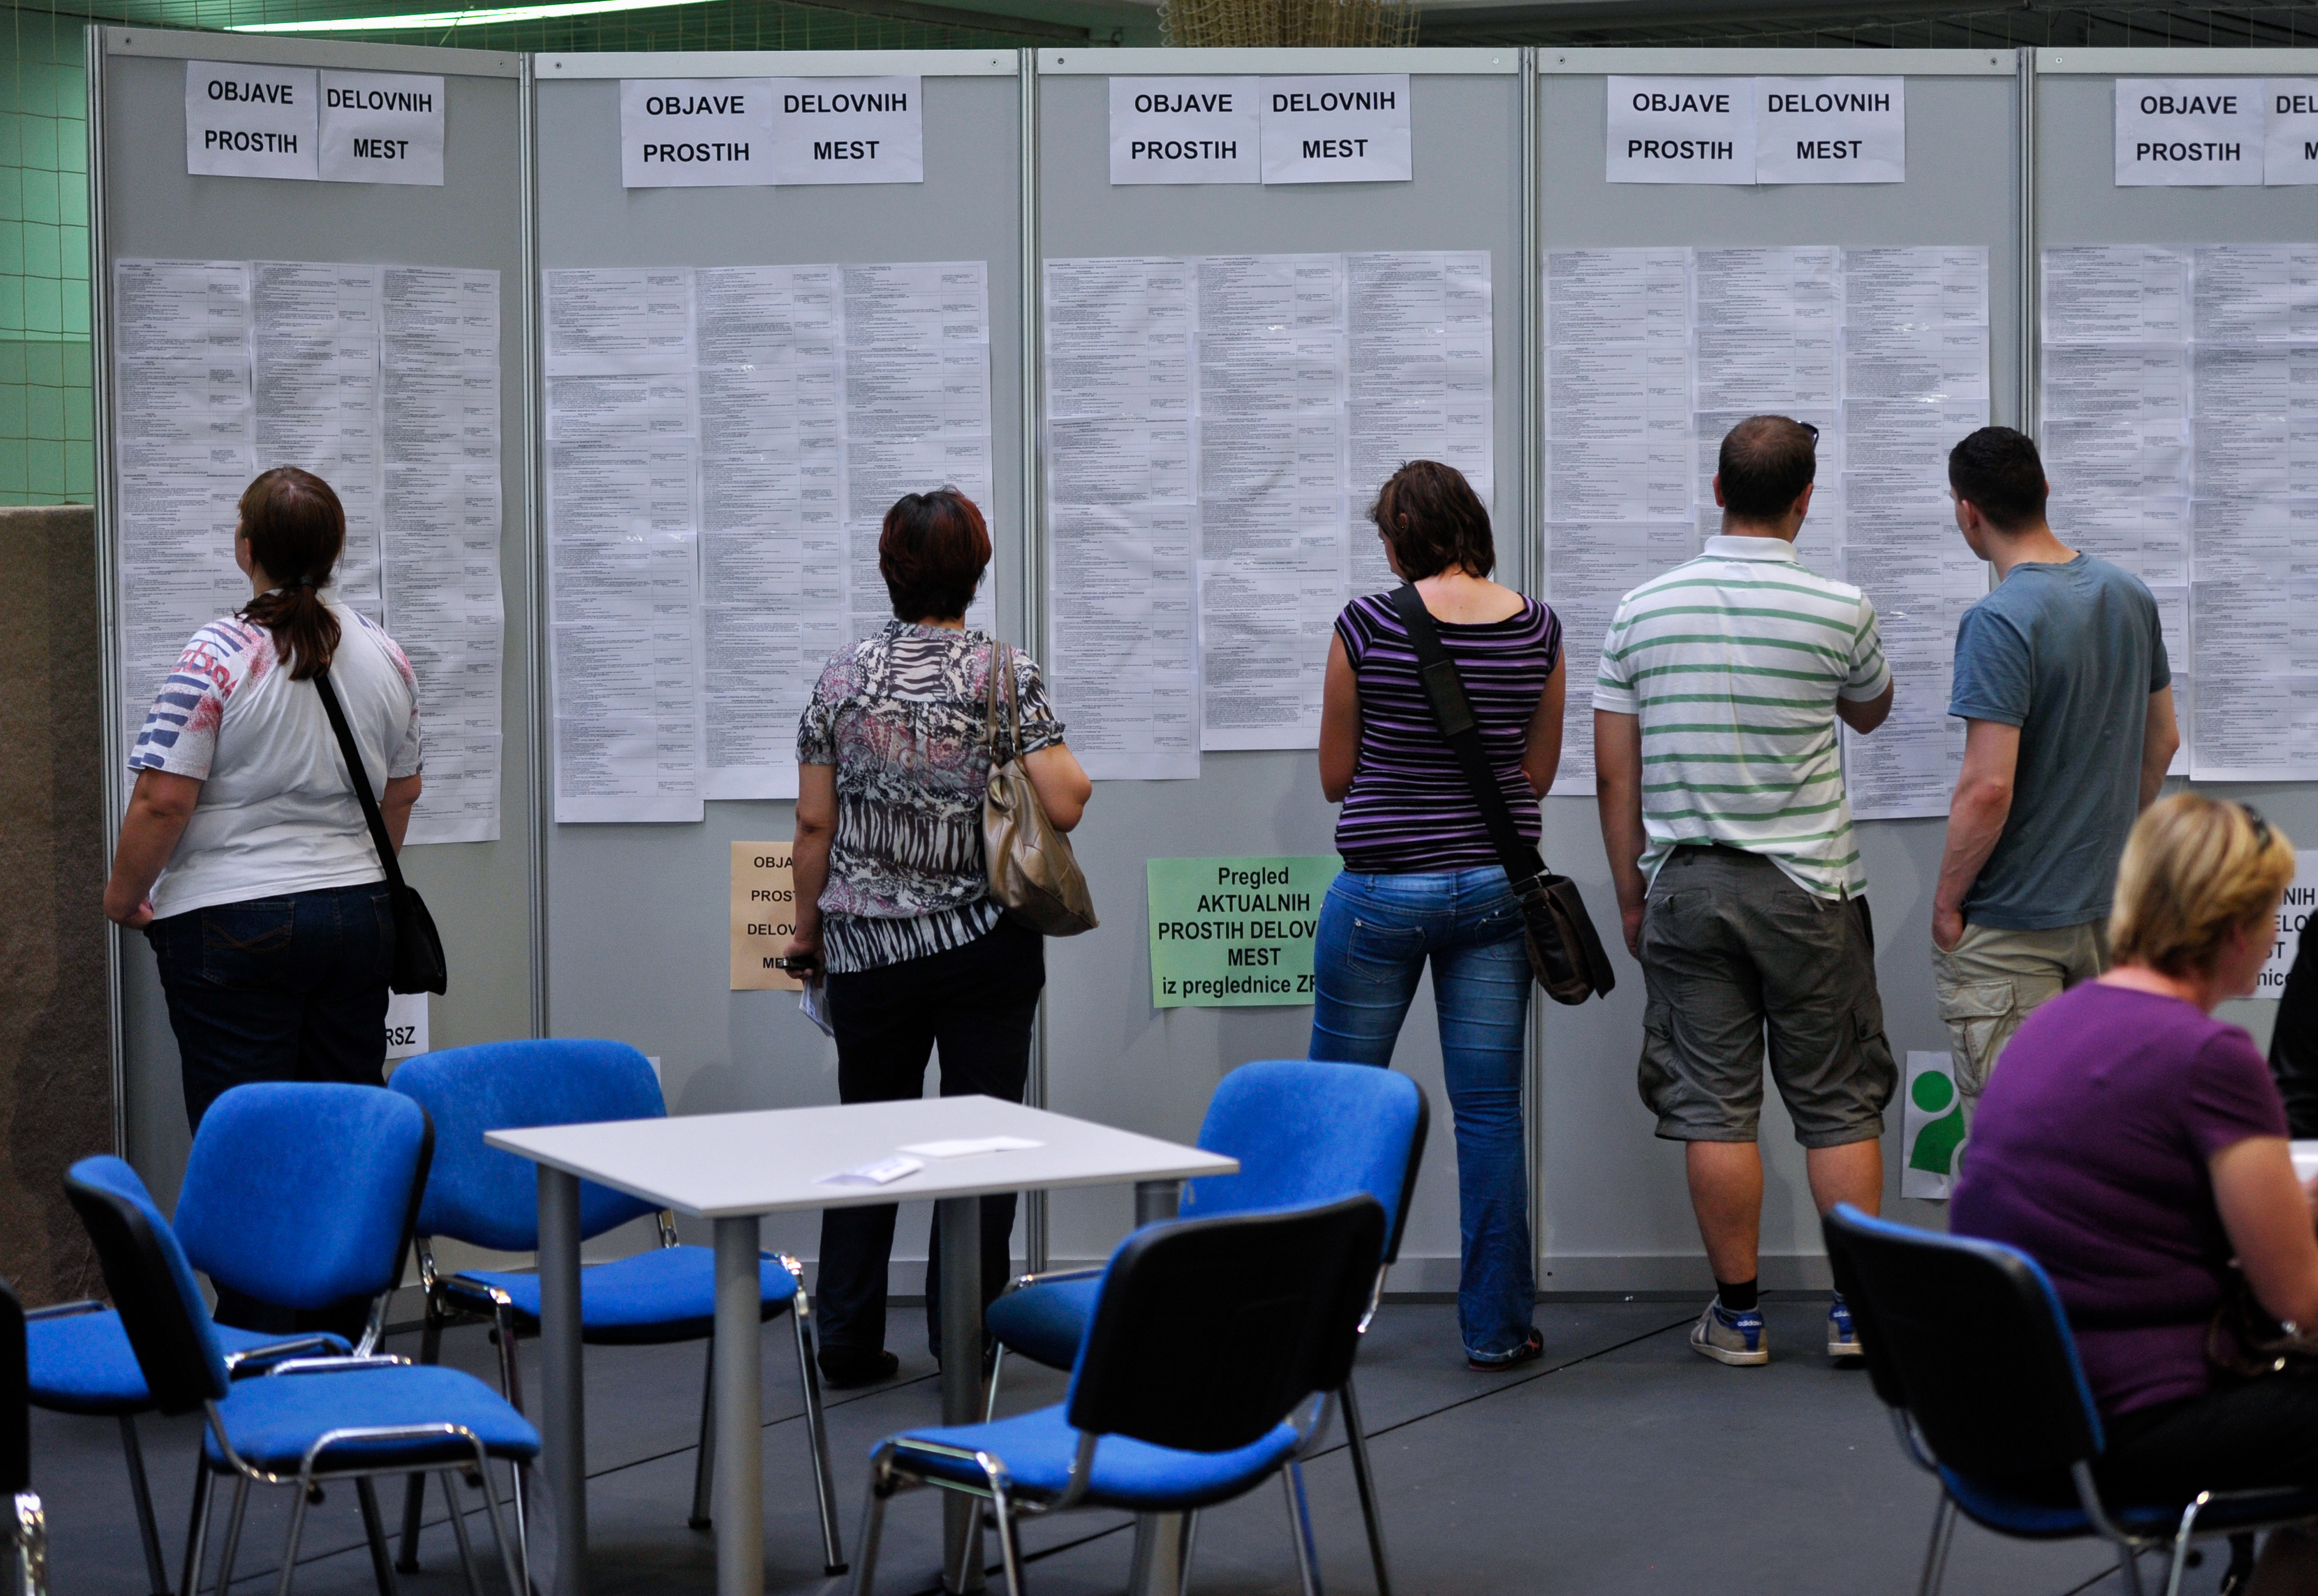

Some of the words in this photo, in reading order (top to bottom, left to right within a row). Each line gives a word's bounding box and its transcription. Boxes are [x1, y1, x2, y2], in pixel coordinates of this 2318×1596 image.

[207, 80, 293, 104] OBJAVE
[327, 89, 432, 112] DELOVNIH
[646, 96, 745, 115] OBJAVE
[784, 93, 907, 113] DELOVNIH
[1135, 94, 1233, 113] OBJAVE
[1273, 92, 1395, 112] DELOVNIH
[1632, 93, 1730, 113] OBJAVE
[1769, 93, 1889, 112] DELOVNIH
[2141, 96, 2237, 115] OBJAVE
[205, 130, 297, 154] PROSTIH
[353, 138, 409, 159] MEST
[814, 141, 880, 160] MEST
[1132, 141, 1237, 159] PROSTIH
[1303, 139, 1368, 158] MEST
[1628, 140, 1733, 159] PROSTIH
[1797, 140, 1863, 159] MEST
[644, 143, 749, 162] PROSTIH
[2137, 143, 2240, 161] PROSTIH
[1219, 866, 1289, 890] Pregled
[752, 890, 796, 902] PROS
[1197, 893, 1310, 913] AKTUALNIH
[1158, 921, 1244, 940] PROSTIH
[1251, 920, 1317, 939] DELOV
[1228, 948, 1281, 966] MEST
[1162, 976, 1177, 994] iz
[1183, 975, 1291, 999] preglednice
